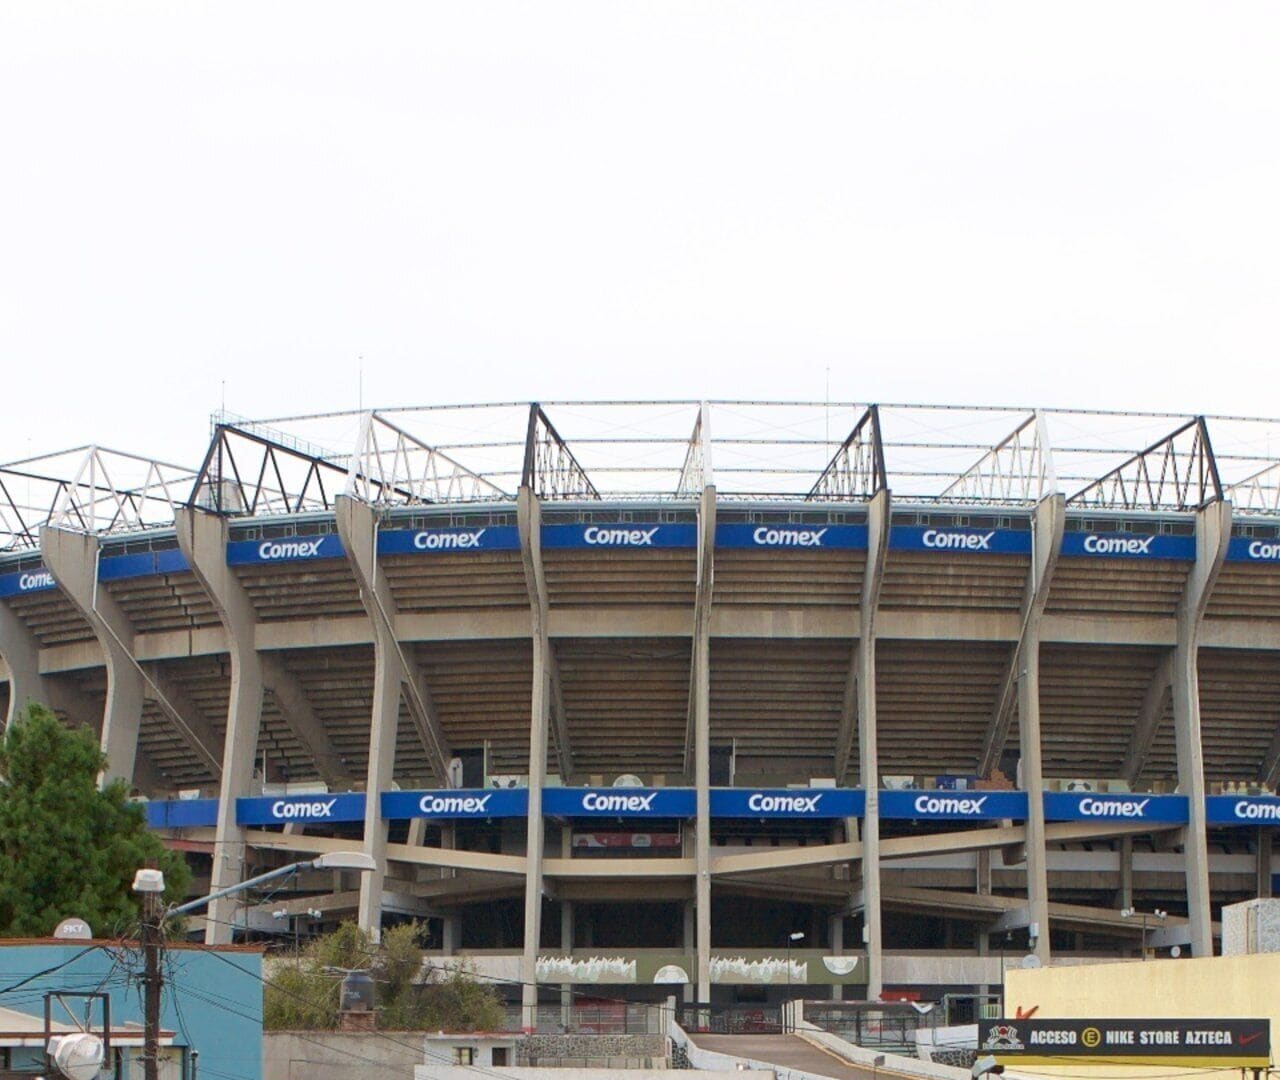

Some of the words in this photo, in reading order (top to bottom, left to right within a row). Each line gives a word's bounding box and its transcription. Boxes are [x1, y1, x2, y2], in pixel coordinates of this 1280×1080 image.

[413, 529, 486, 549] Comex
[583, 526, 659, 546] Comex
[753, 526, 828, 546] Comex
[922, 531, 995, 550] Comex
[1083, 535, 1155, 554] Comex
[258, 538, 325, 560] Comex
[20, 573, 55, 590] Come
[271, 798, 337, 818] Comex
[419, 794, 492, 813] Comex
[582, 792, 658, 811] Comex
[748, 793, 822, 813] Comex
[914, 795, 988, 815] Comex
[1078, 798, 1150, 817] Comex
[1030, 1030, 1077, 1045] ACCESO
[1106, 1030, 1134, 1045] NIKE
[1139, 1030, 1180, 1045] STORE
[1185, 1030, 1233, 1045] AZTECA
